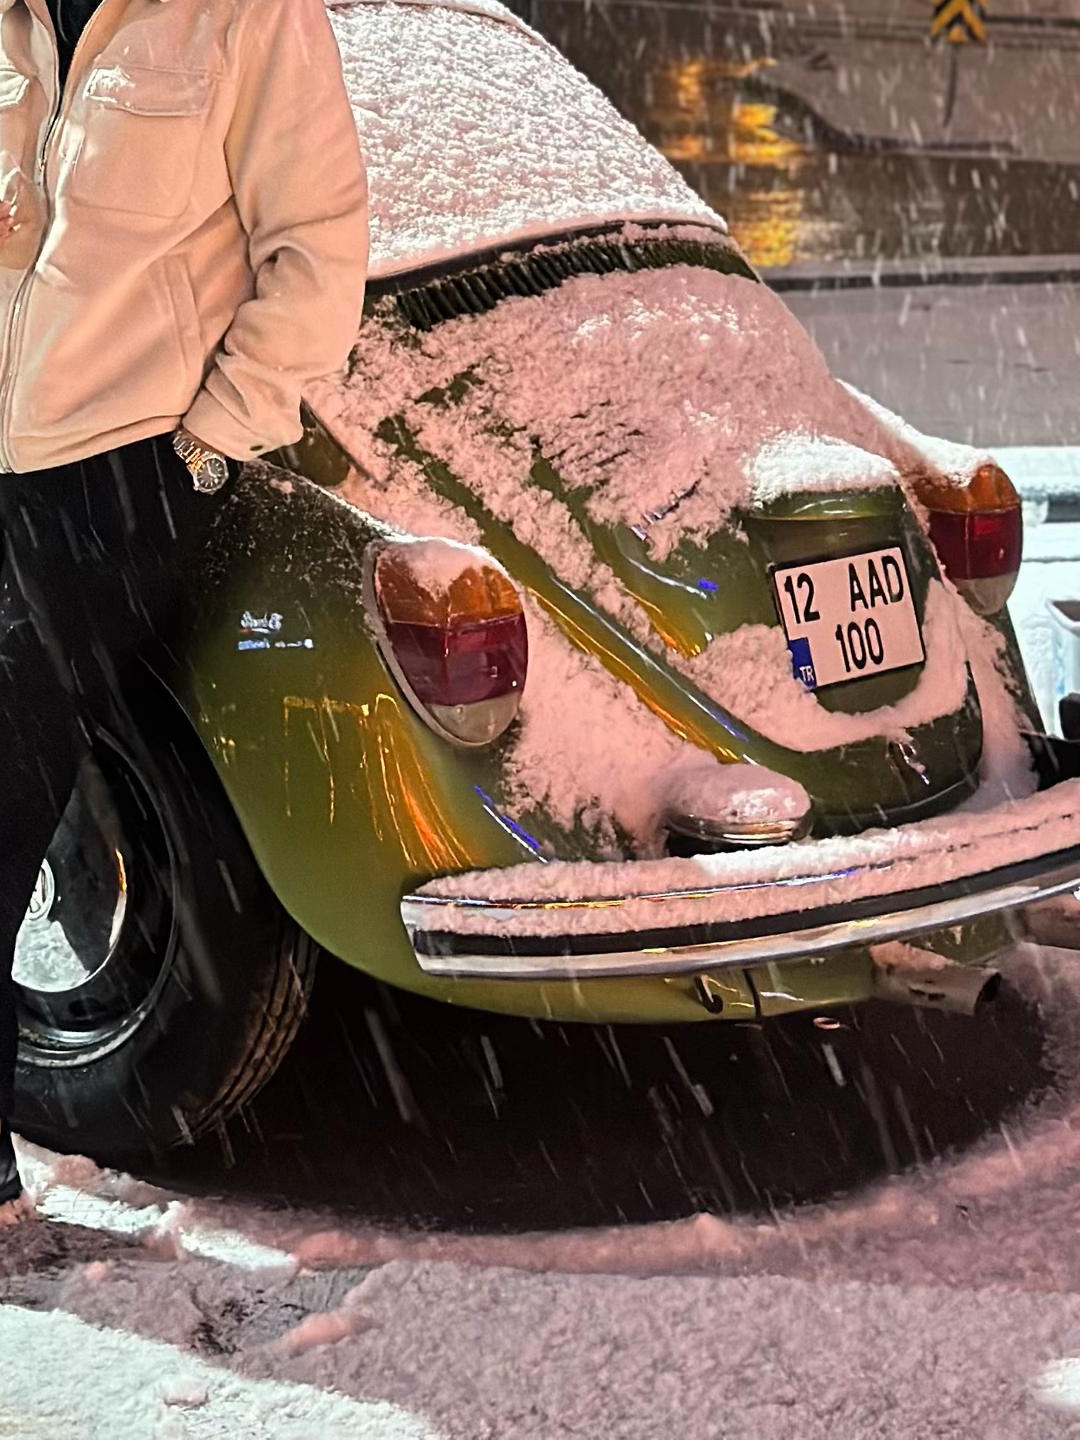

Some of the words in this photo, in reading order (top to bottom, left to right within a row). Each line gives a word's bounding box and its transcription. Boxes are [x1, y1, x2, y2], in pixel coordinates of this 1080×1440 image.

[783, 572, 821, 624] 12
[848, 555, 904, 612] AAD
[799, 665, 815, 681] TR
[835, 617, 884, 673] 100
